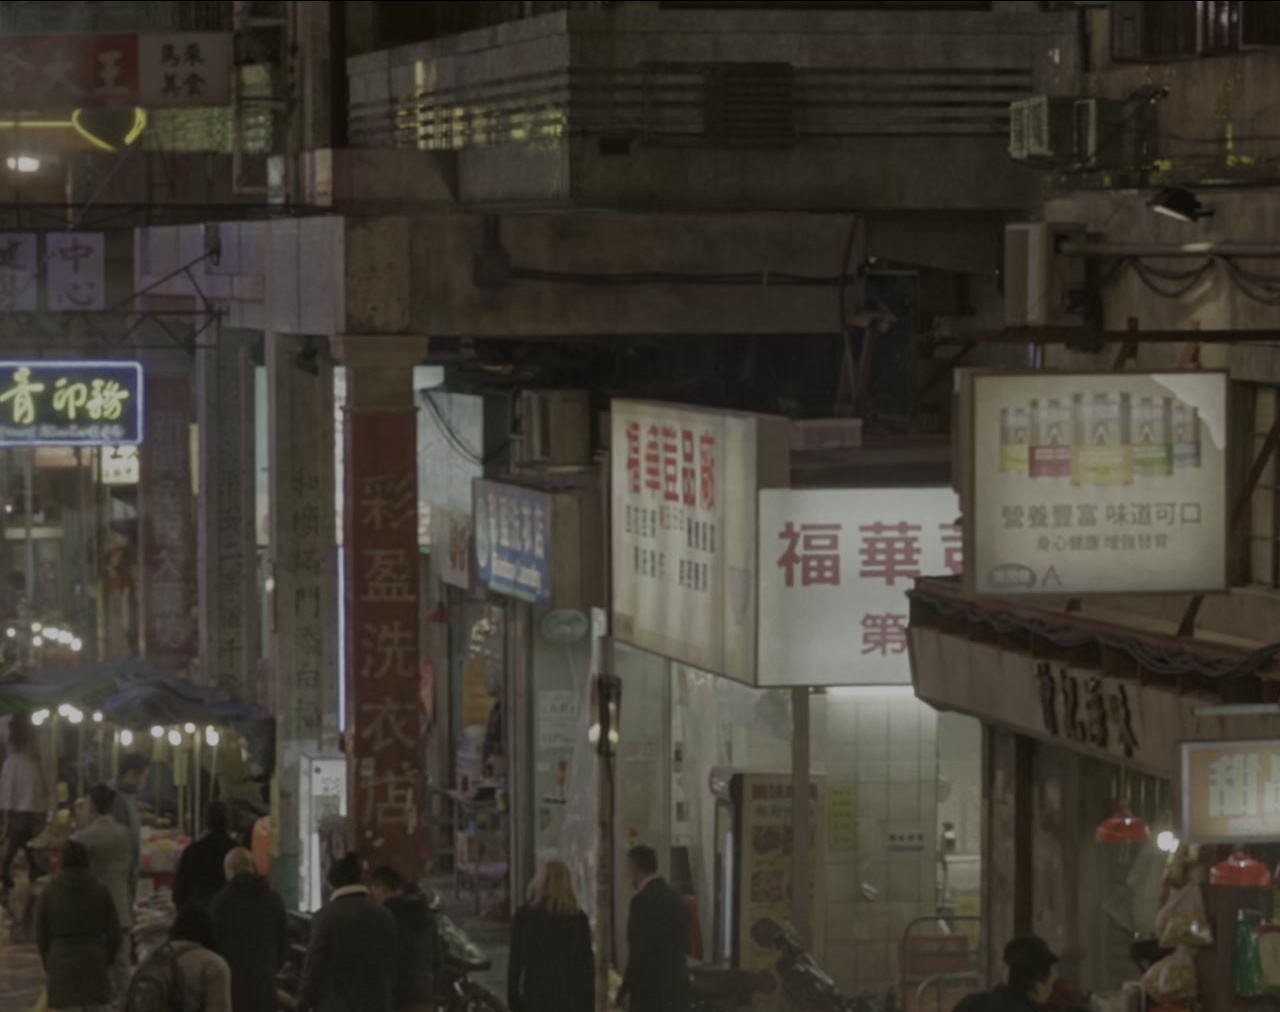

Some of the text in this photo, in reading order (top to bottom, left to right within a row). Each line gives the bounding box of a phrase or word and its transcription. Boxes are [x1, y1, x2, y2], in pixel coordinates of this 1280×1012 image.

[1001, 501, 1202, 529] 營養豐富 味道可口
